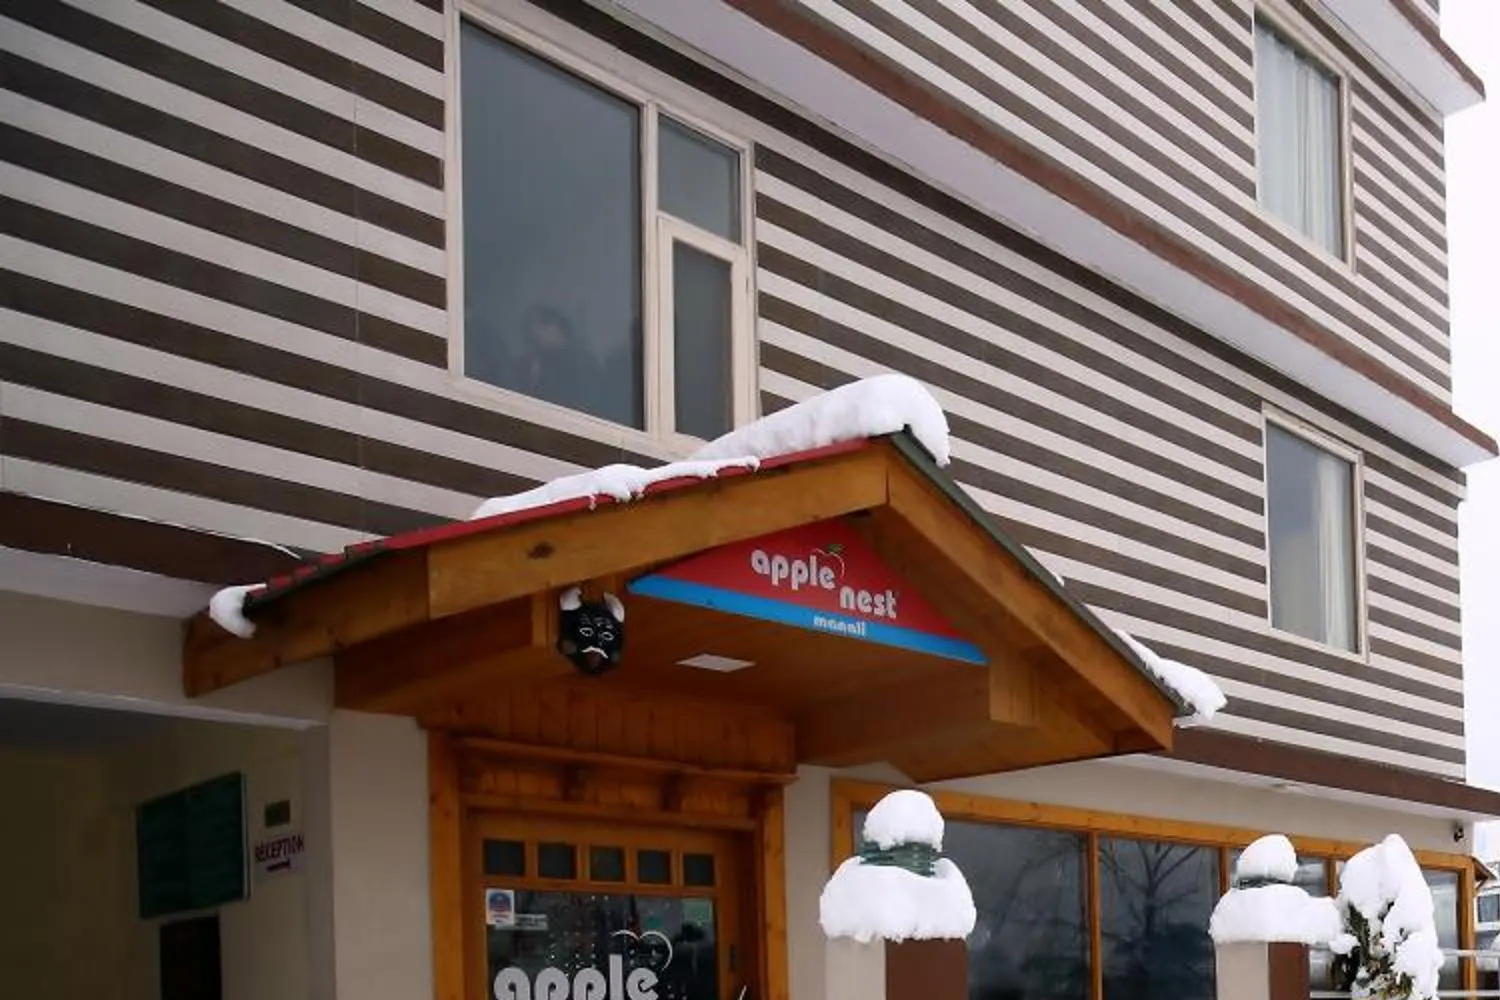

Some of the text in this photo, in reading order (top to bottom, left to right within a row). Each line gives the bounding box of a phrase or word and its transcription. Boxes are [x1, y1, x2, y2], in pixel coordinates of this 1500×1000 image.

[751, 549, 836, 591] apple
[839, 585, 897, 619] nest
[813, 615, 866, 637] manali
[255, 834, 304, 863] RECEPTION
